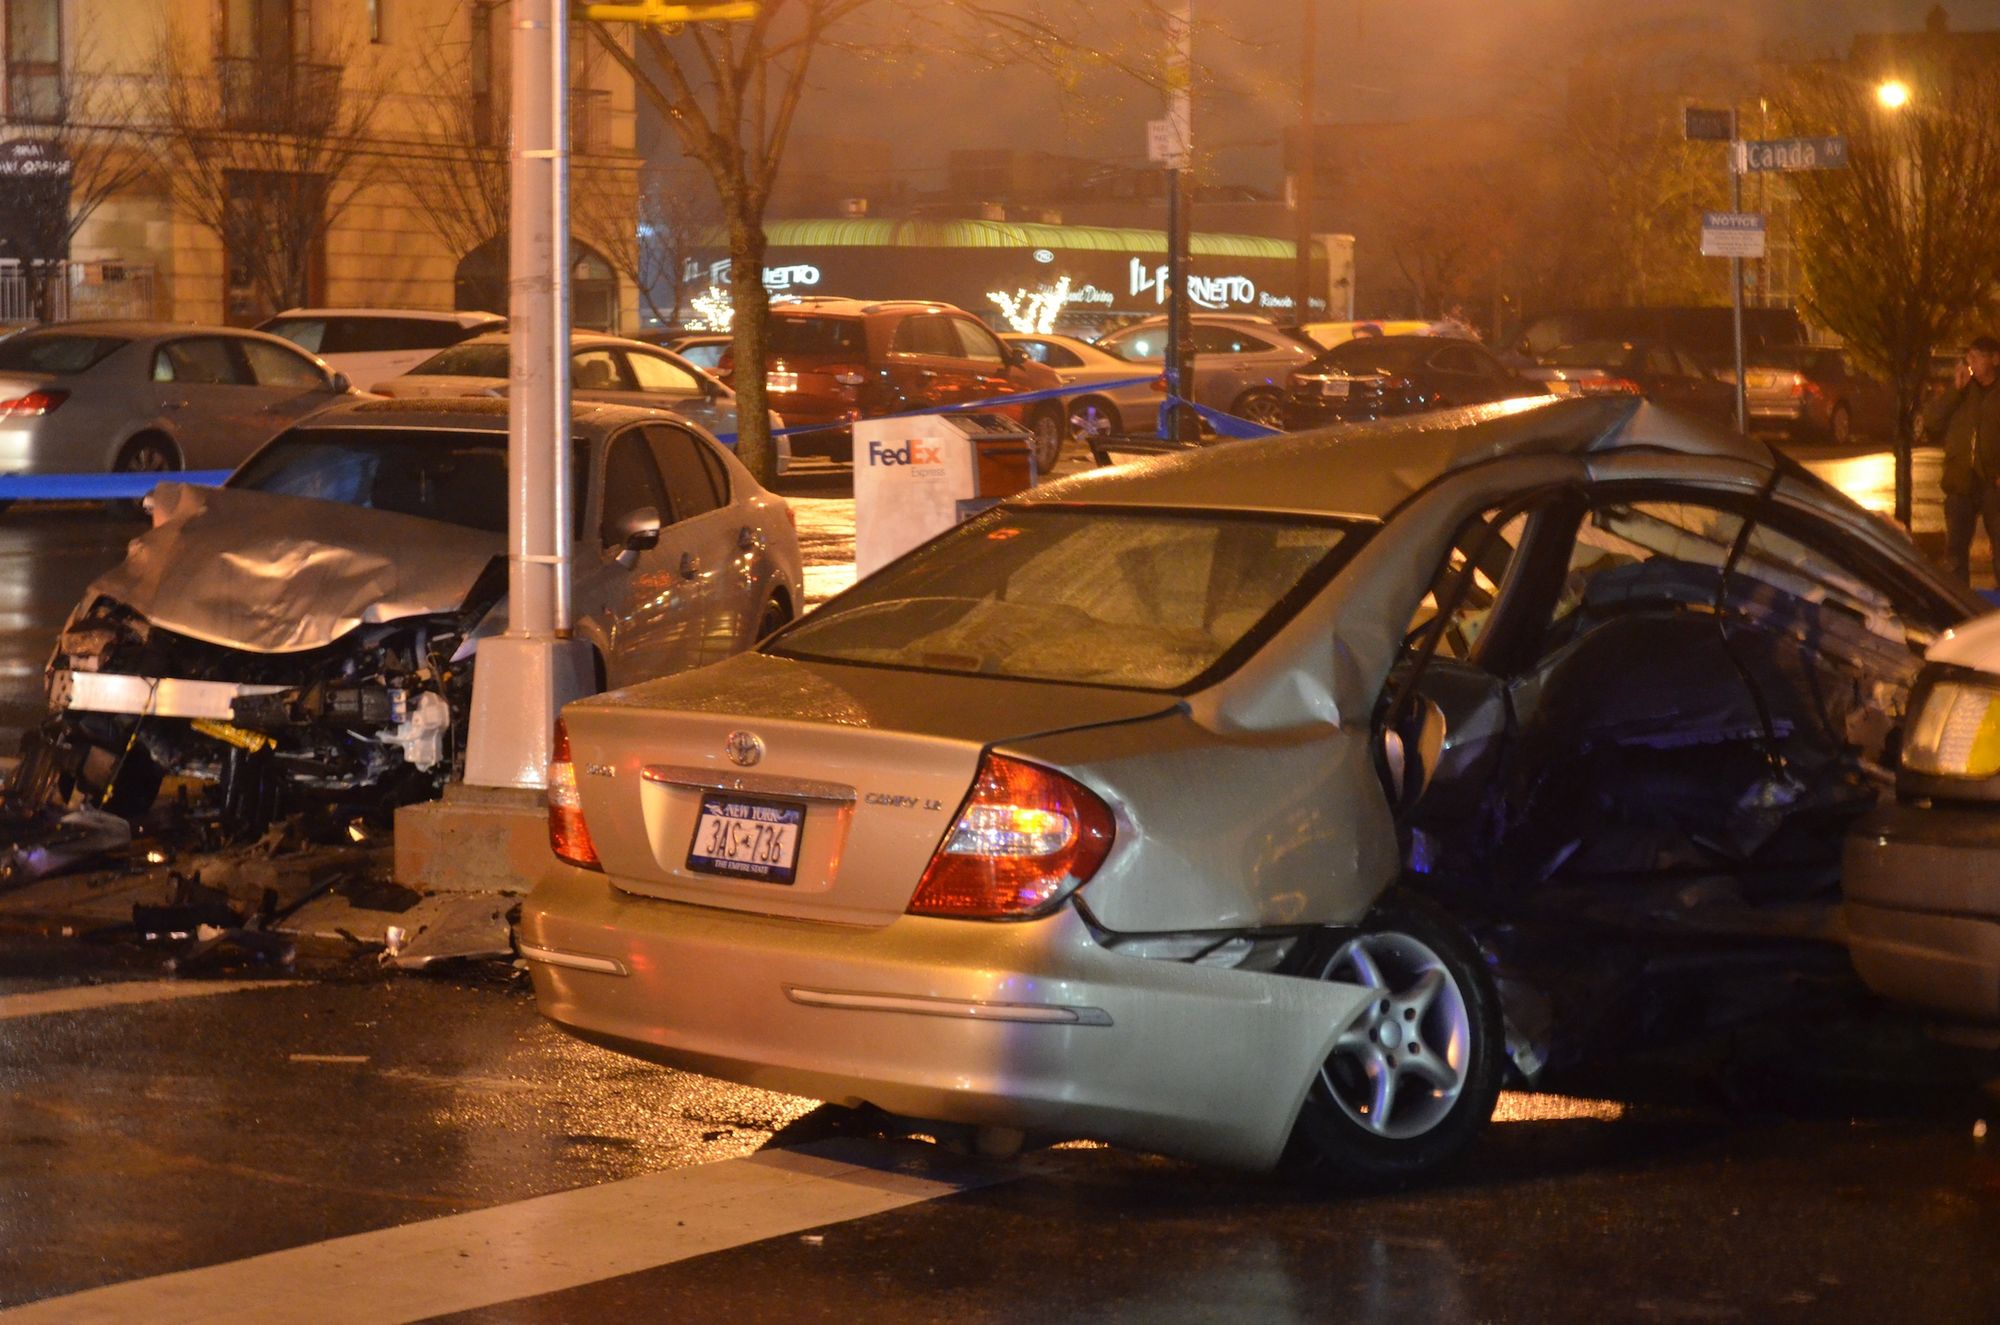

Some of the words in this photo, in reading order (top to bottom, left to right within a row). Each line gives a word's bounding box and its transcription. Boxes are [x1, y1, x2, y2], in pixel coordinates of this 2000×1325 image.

[1709, 215, 1759, 227] NOTICE
[869, 438, 941, 466] FedEx
[911, 467, 946, 477] Express
[726, 804, 748, 818] NEW
[752, 806, 779, 822] YORK
[707, 820, 741, 857] 3AS
[752, 824, 784, 863] 736
